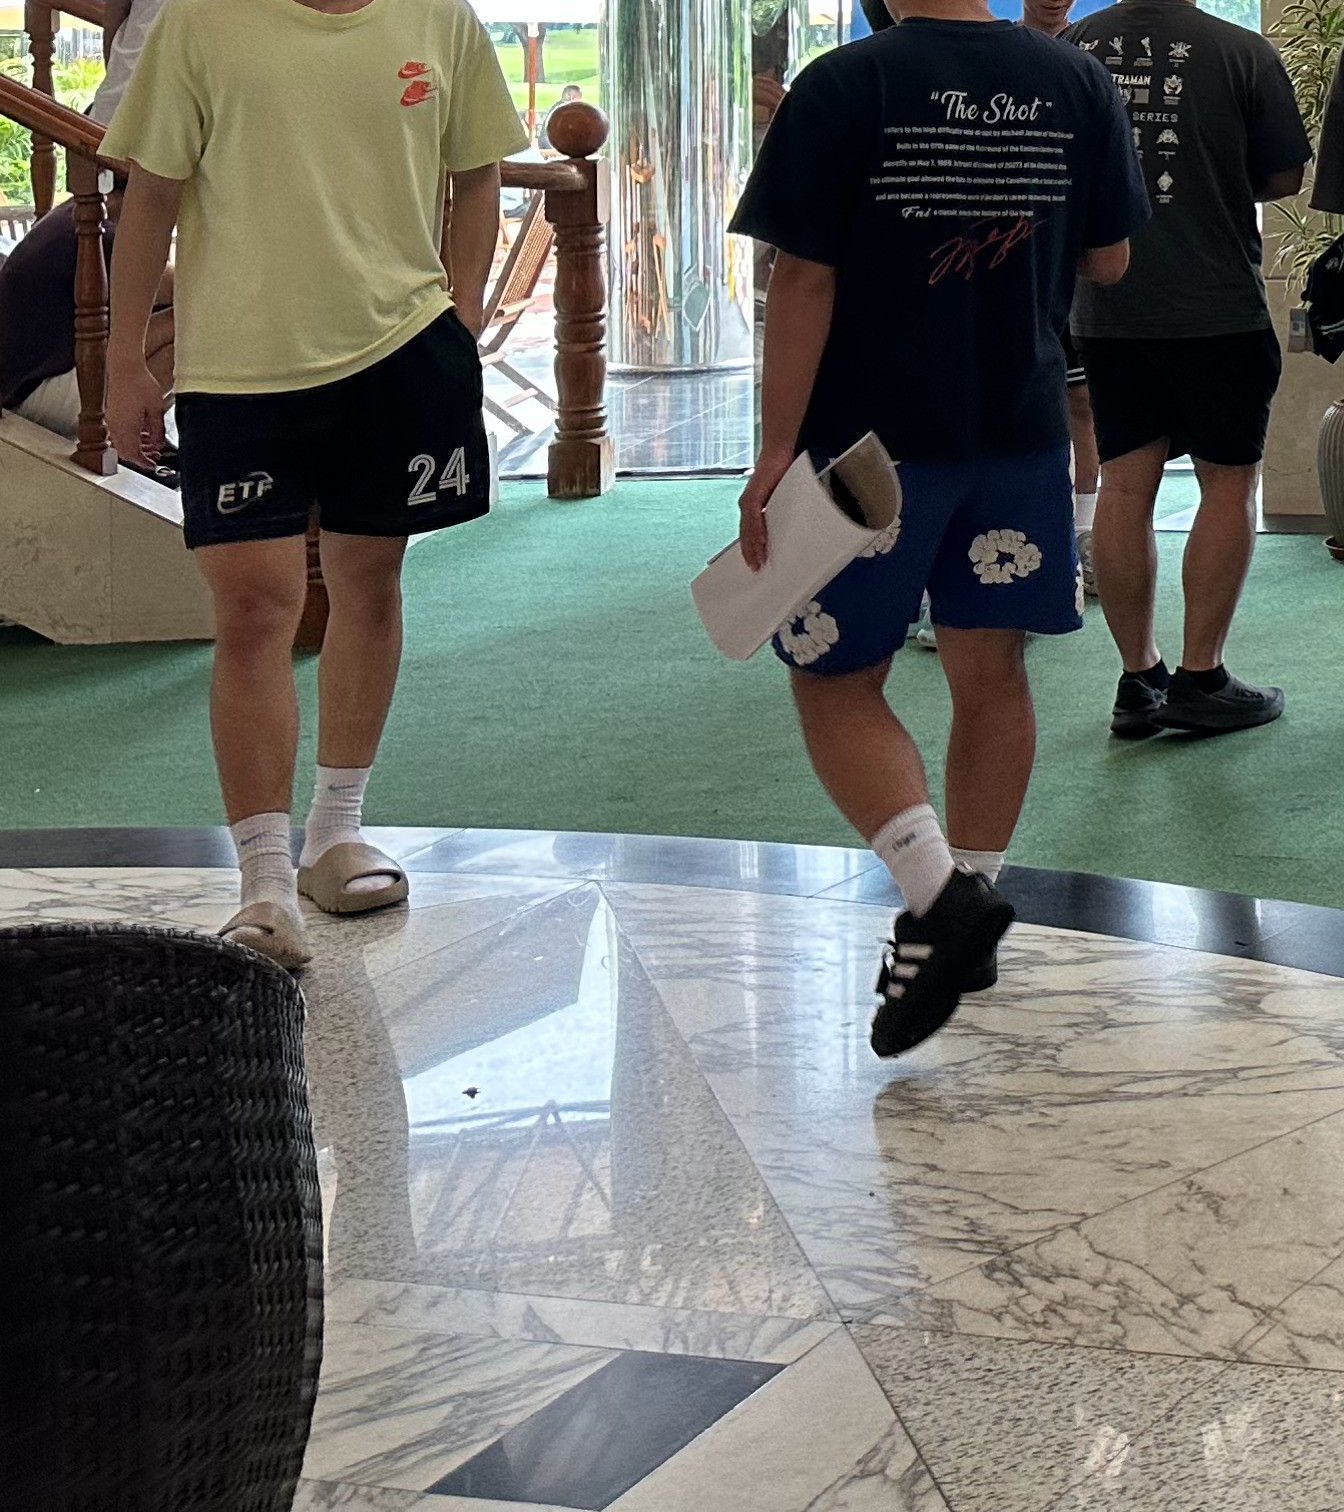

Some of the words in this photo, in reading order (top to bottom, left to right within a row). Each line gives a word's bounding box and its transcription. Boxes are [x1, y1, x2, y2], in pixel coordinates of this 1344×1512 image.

[1111, 73, 1152, 86] TRAMAN
[1132, 111, 1179, 123] SERIES
[407, 446, 471, 506] 24
[218, 479, 273, 503] ETF
